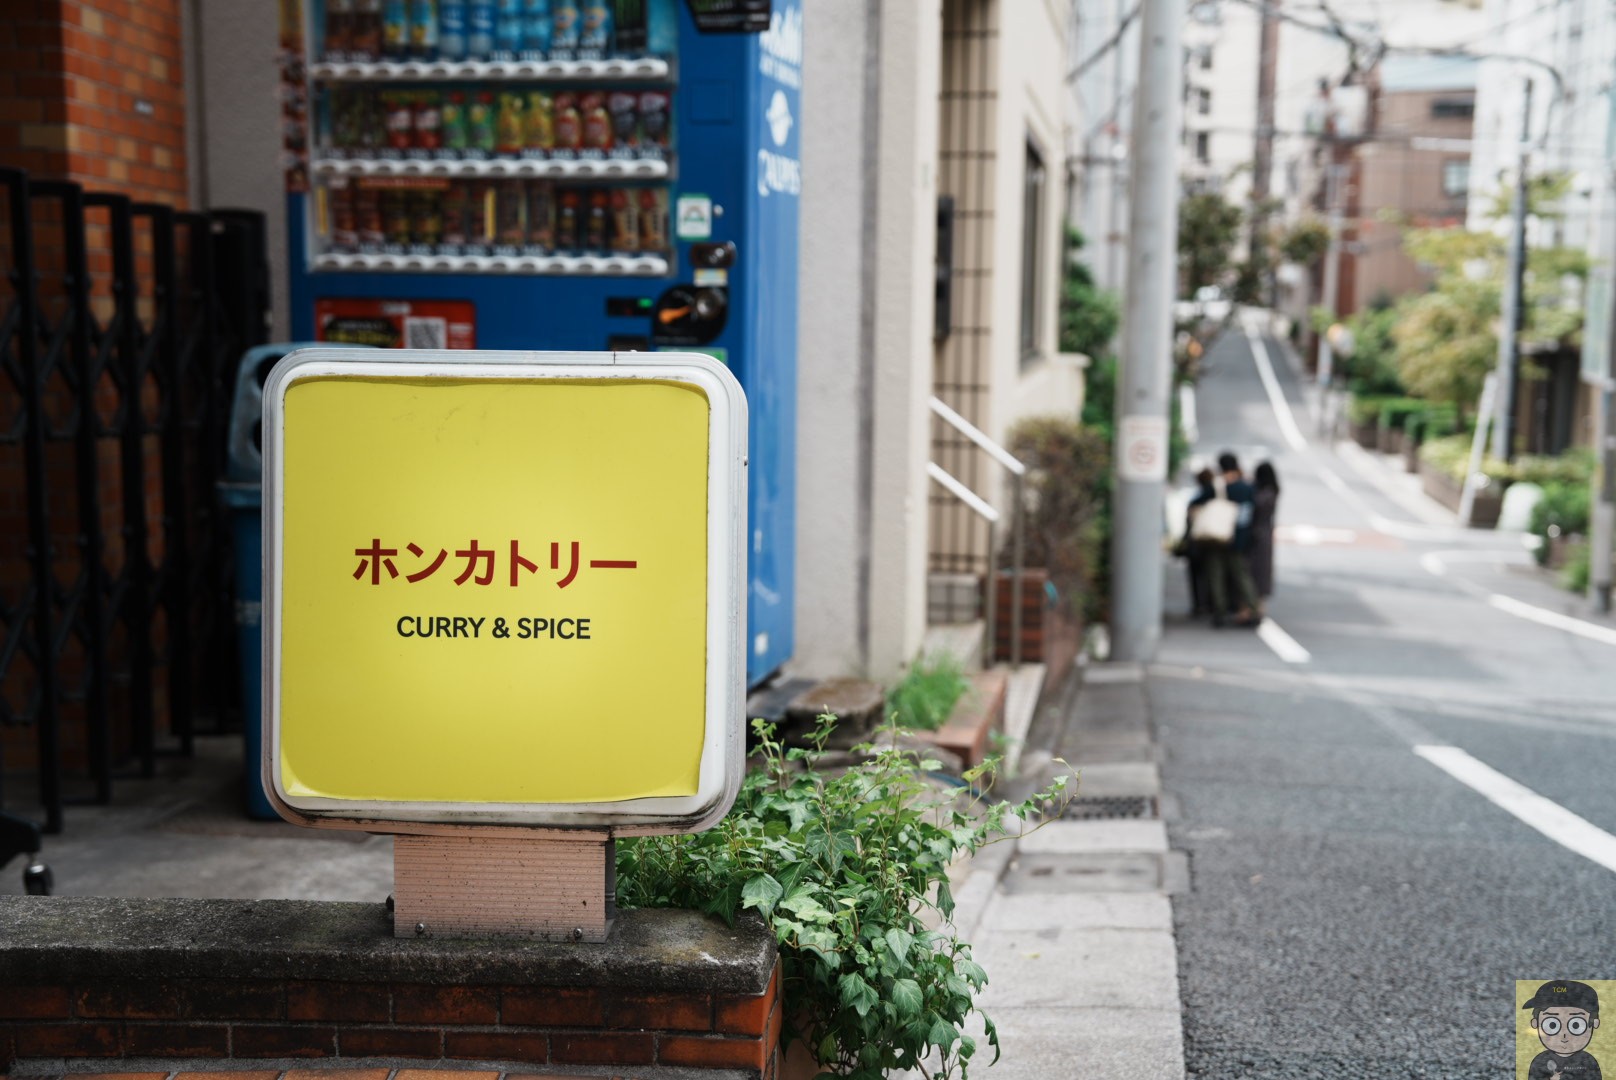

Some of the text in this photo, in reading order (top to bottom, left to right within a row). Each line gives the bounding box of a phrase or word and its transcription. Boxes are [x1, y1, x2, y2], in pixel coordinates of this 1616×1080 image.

[352, 538, 637, 589] ホンカトリー
[396, 615, 591, 640] CURRY & SPICE
